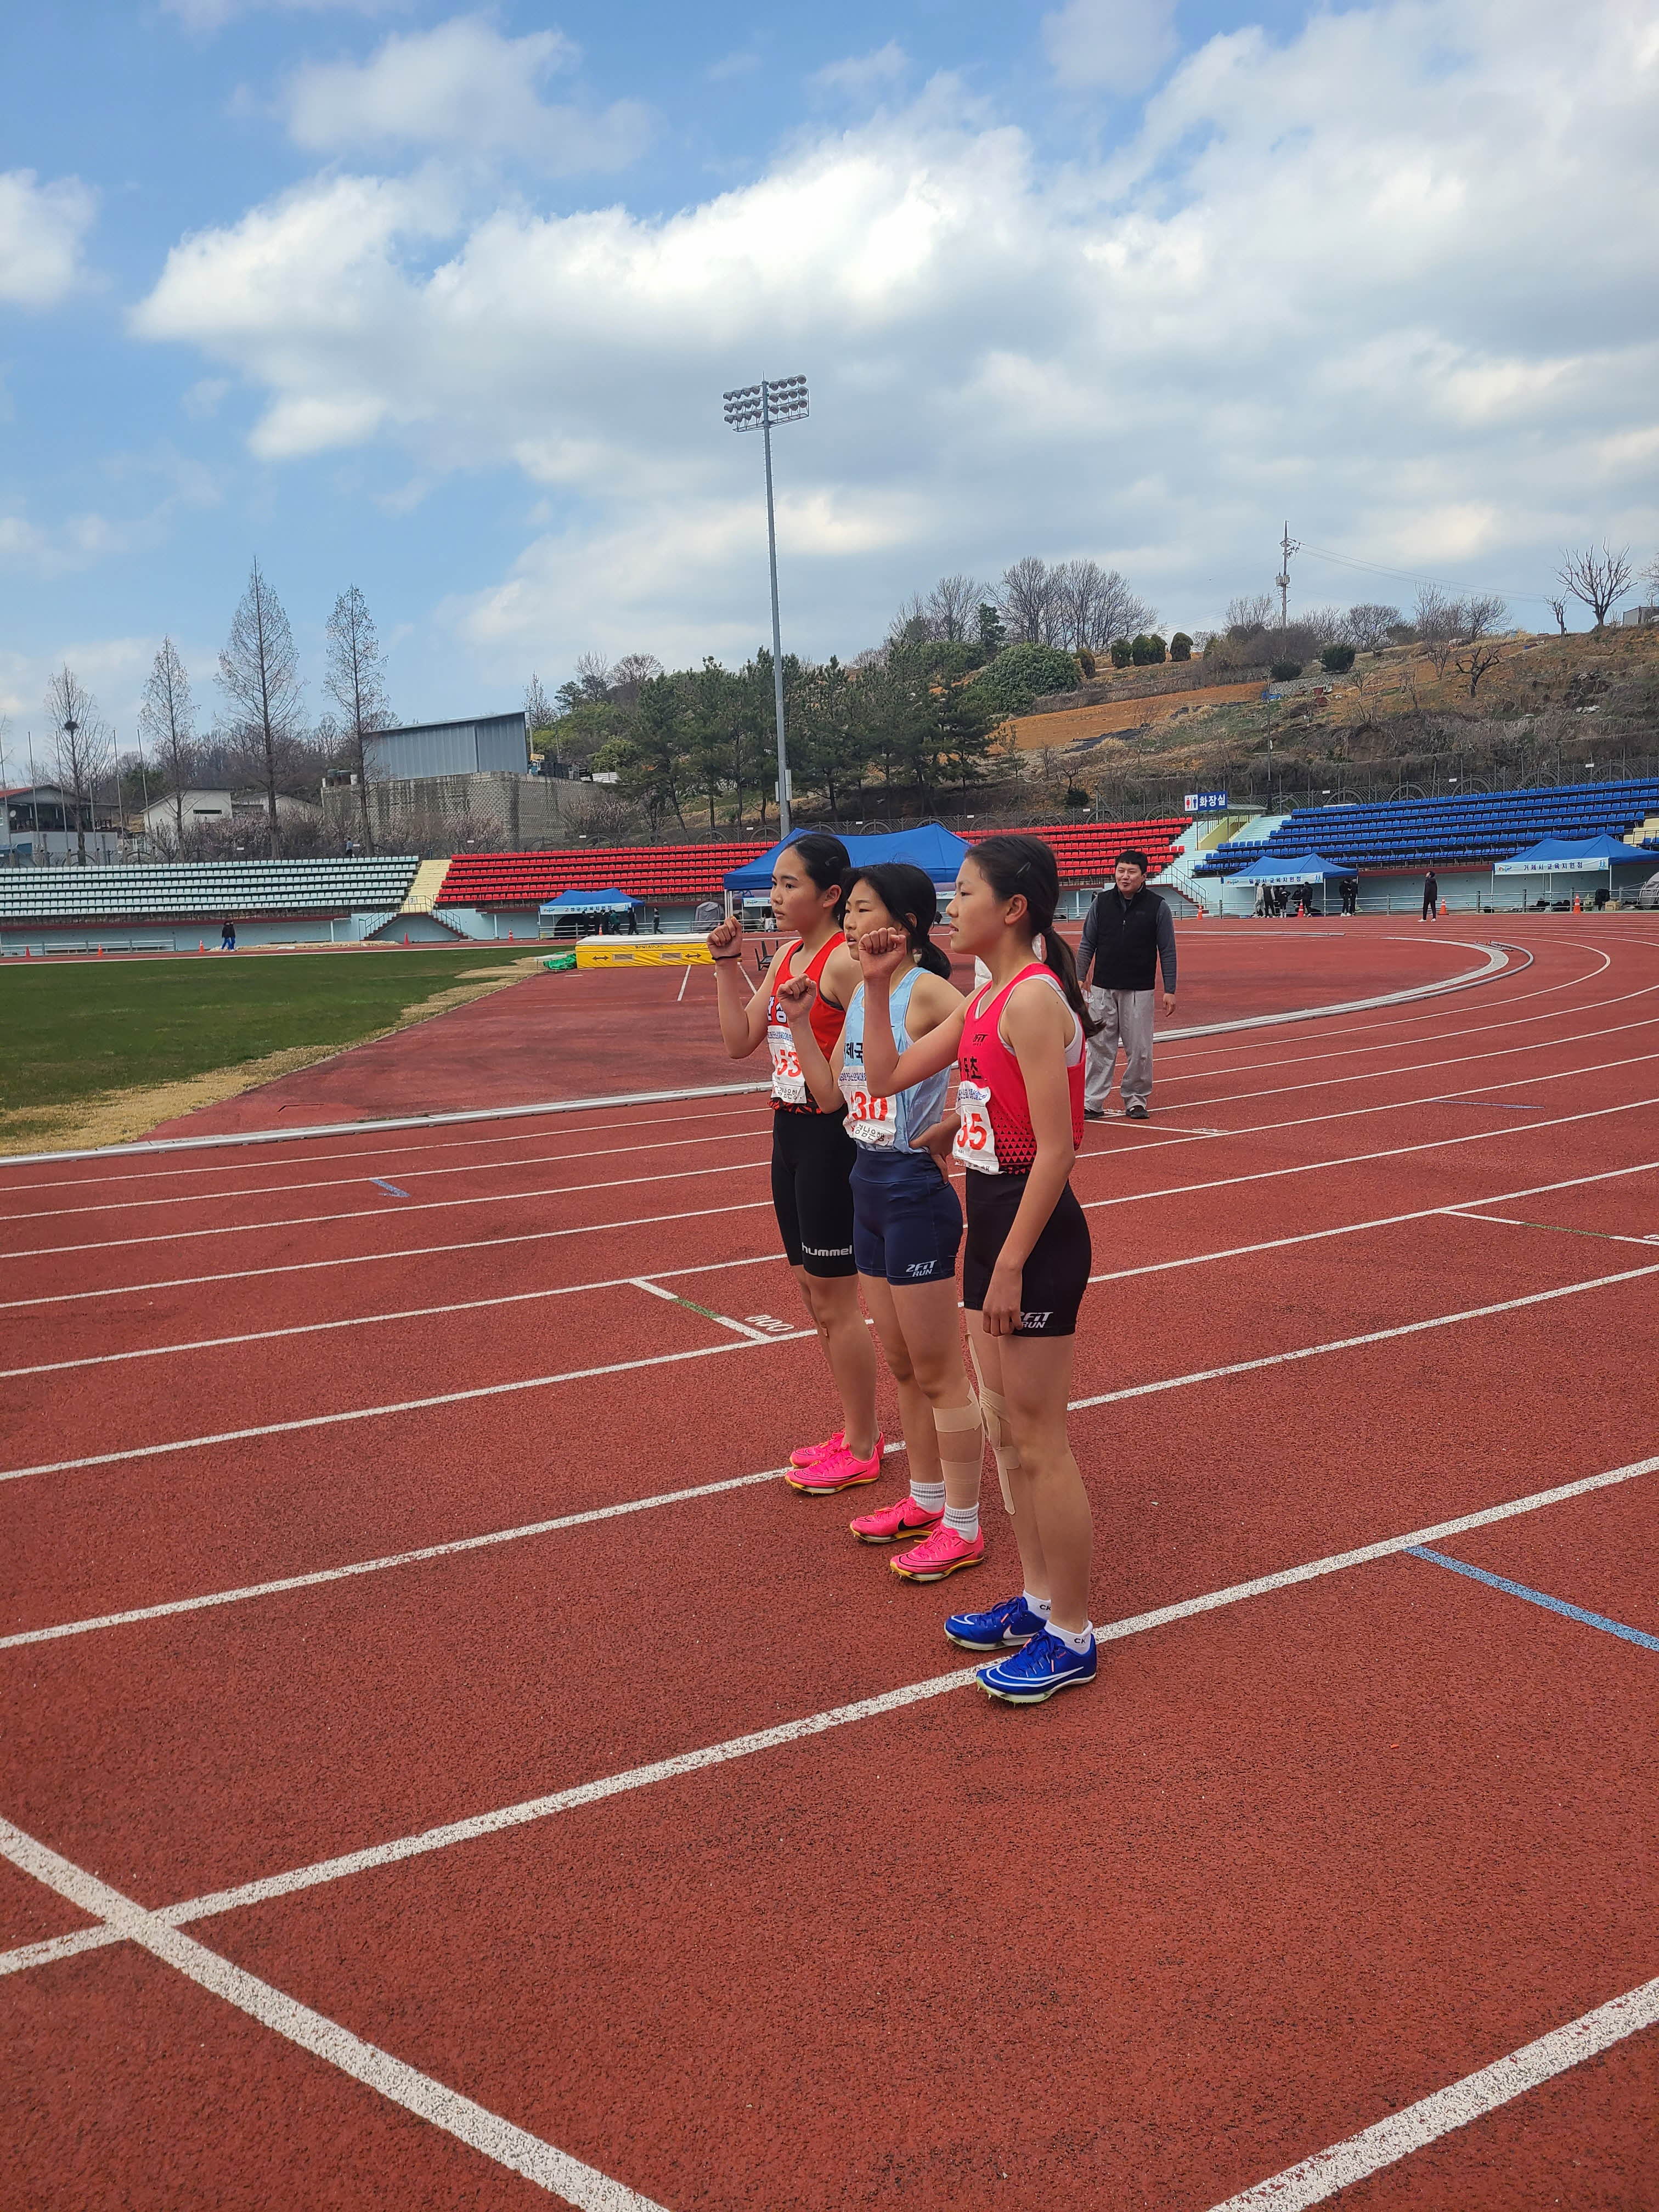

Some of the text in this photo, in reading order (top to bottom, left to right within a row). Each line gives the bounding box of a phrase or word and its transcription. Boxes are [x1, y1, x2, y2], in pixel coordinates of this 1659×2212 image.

[1199, 794, 1226, 807] 화장실
[777, 1087, 798, 1100] 경남은행
[855, 1124, 884, 1142] 경남은행
[802, 1242, 853, 1257] hummel
[912, 1268, 933, 1277] RUN
